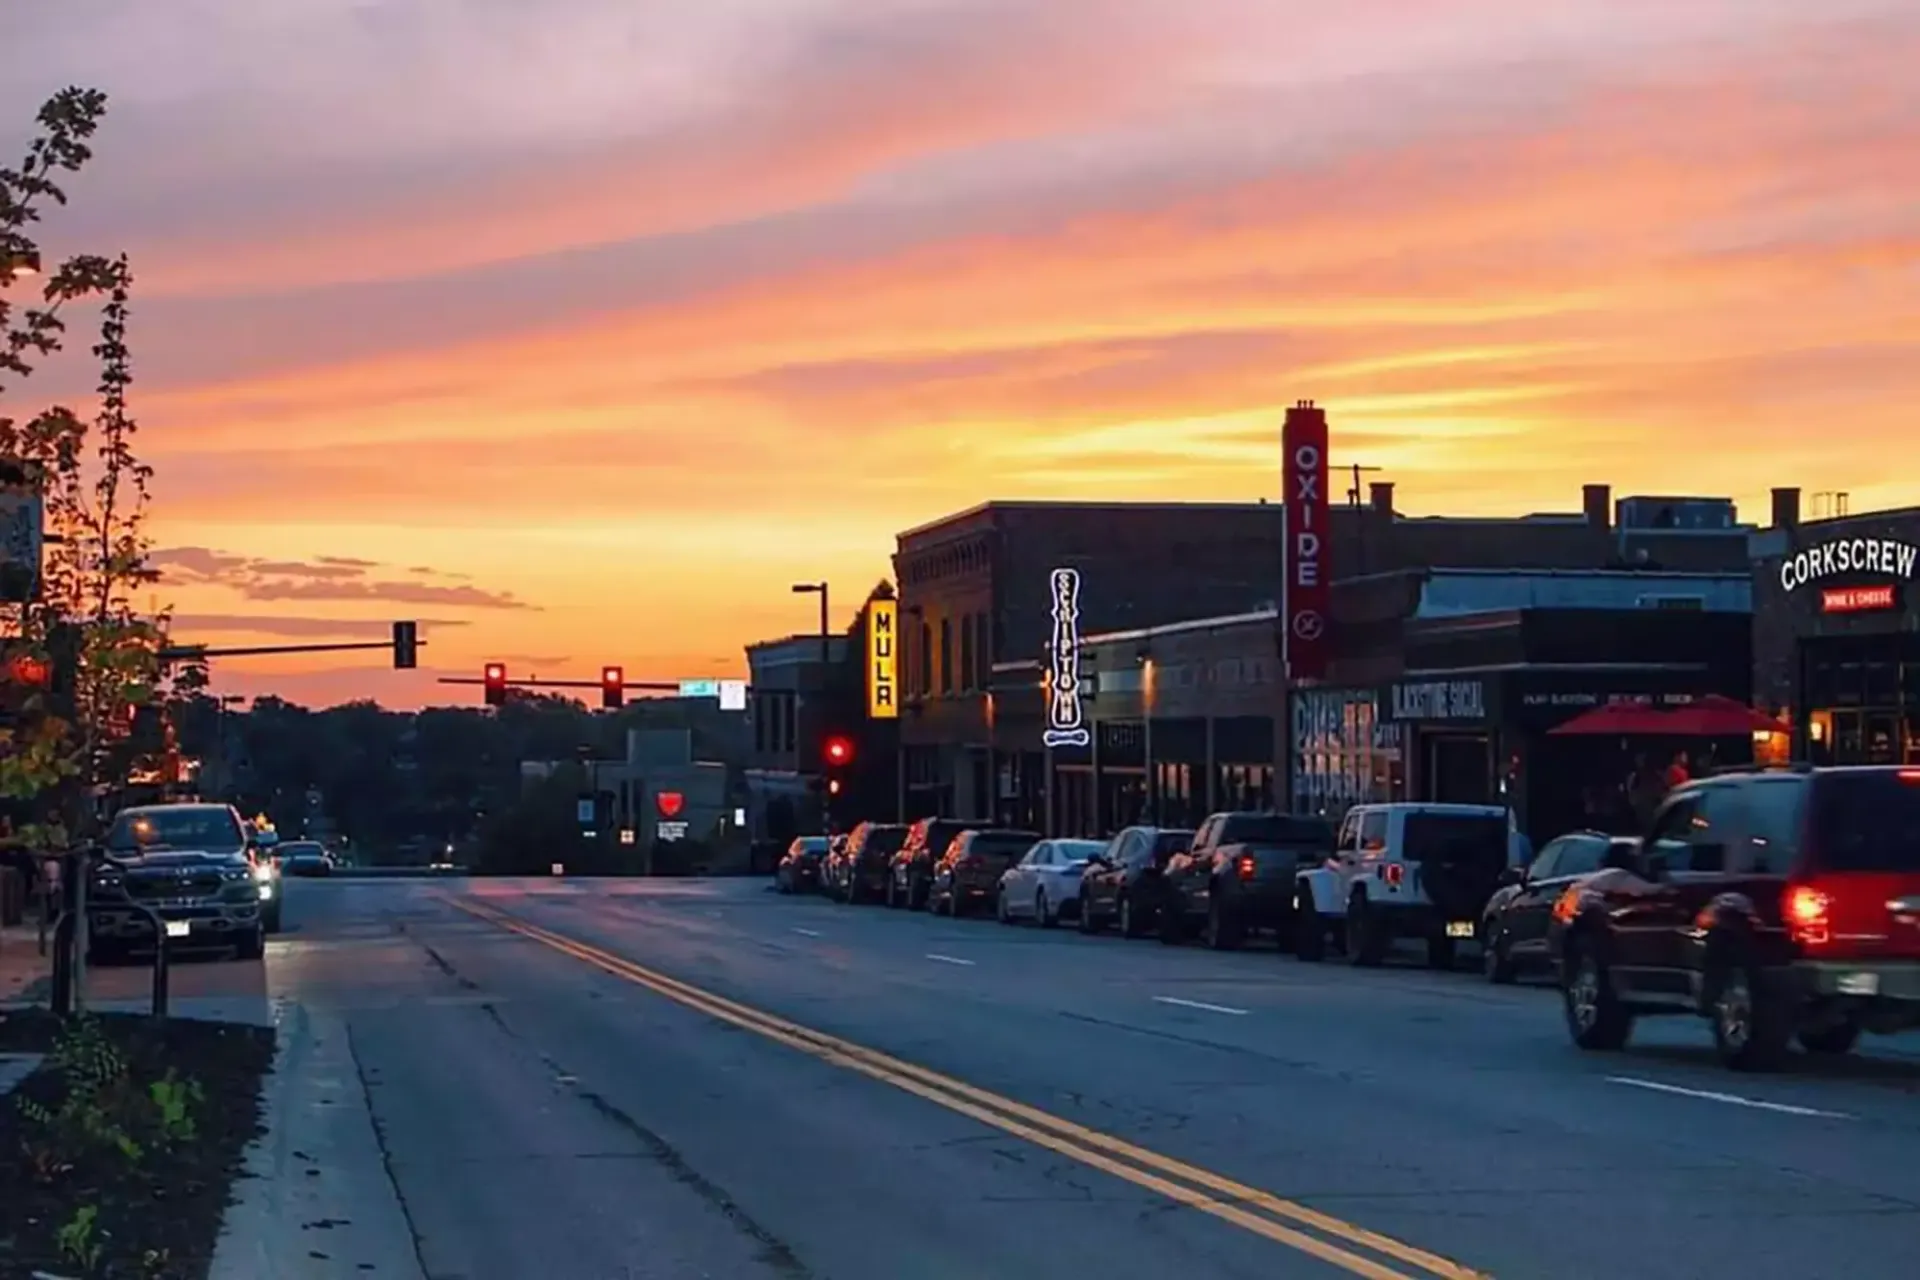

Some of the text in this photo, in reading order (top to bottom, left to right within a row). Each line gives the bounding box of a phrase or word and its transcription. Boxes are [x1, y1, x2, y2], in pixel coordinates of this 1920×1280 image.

[1295, 446, 1319, 586] OXIDE
[1781, 538, 1917, 591] CORKSCREW
[876, 612, 891, 705] MULA
[1058, 573, 1073, 722] SCRIPTOWN
